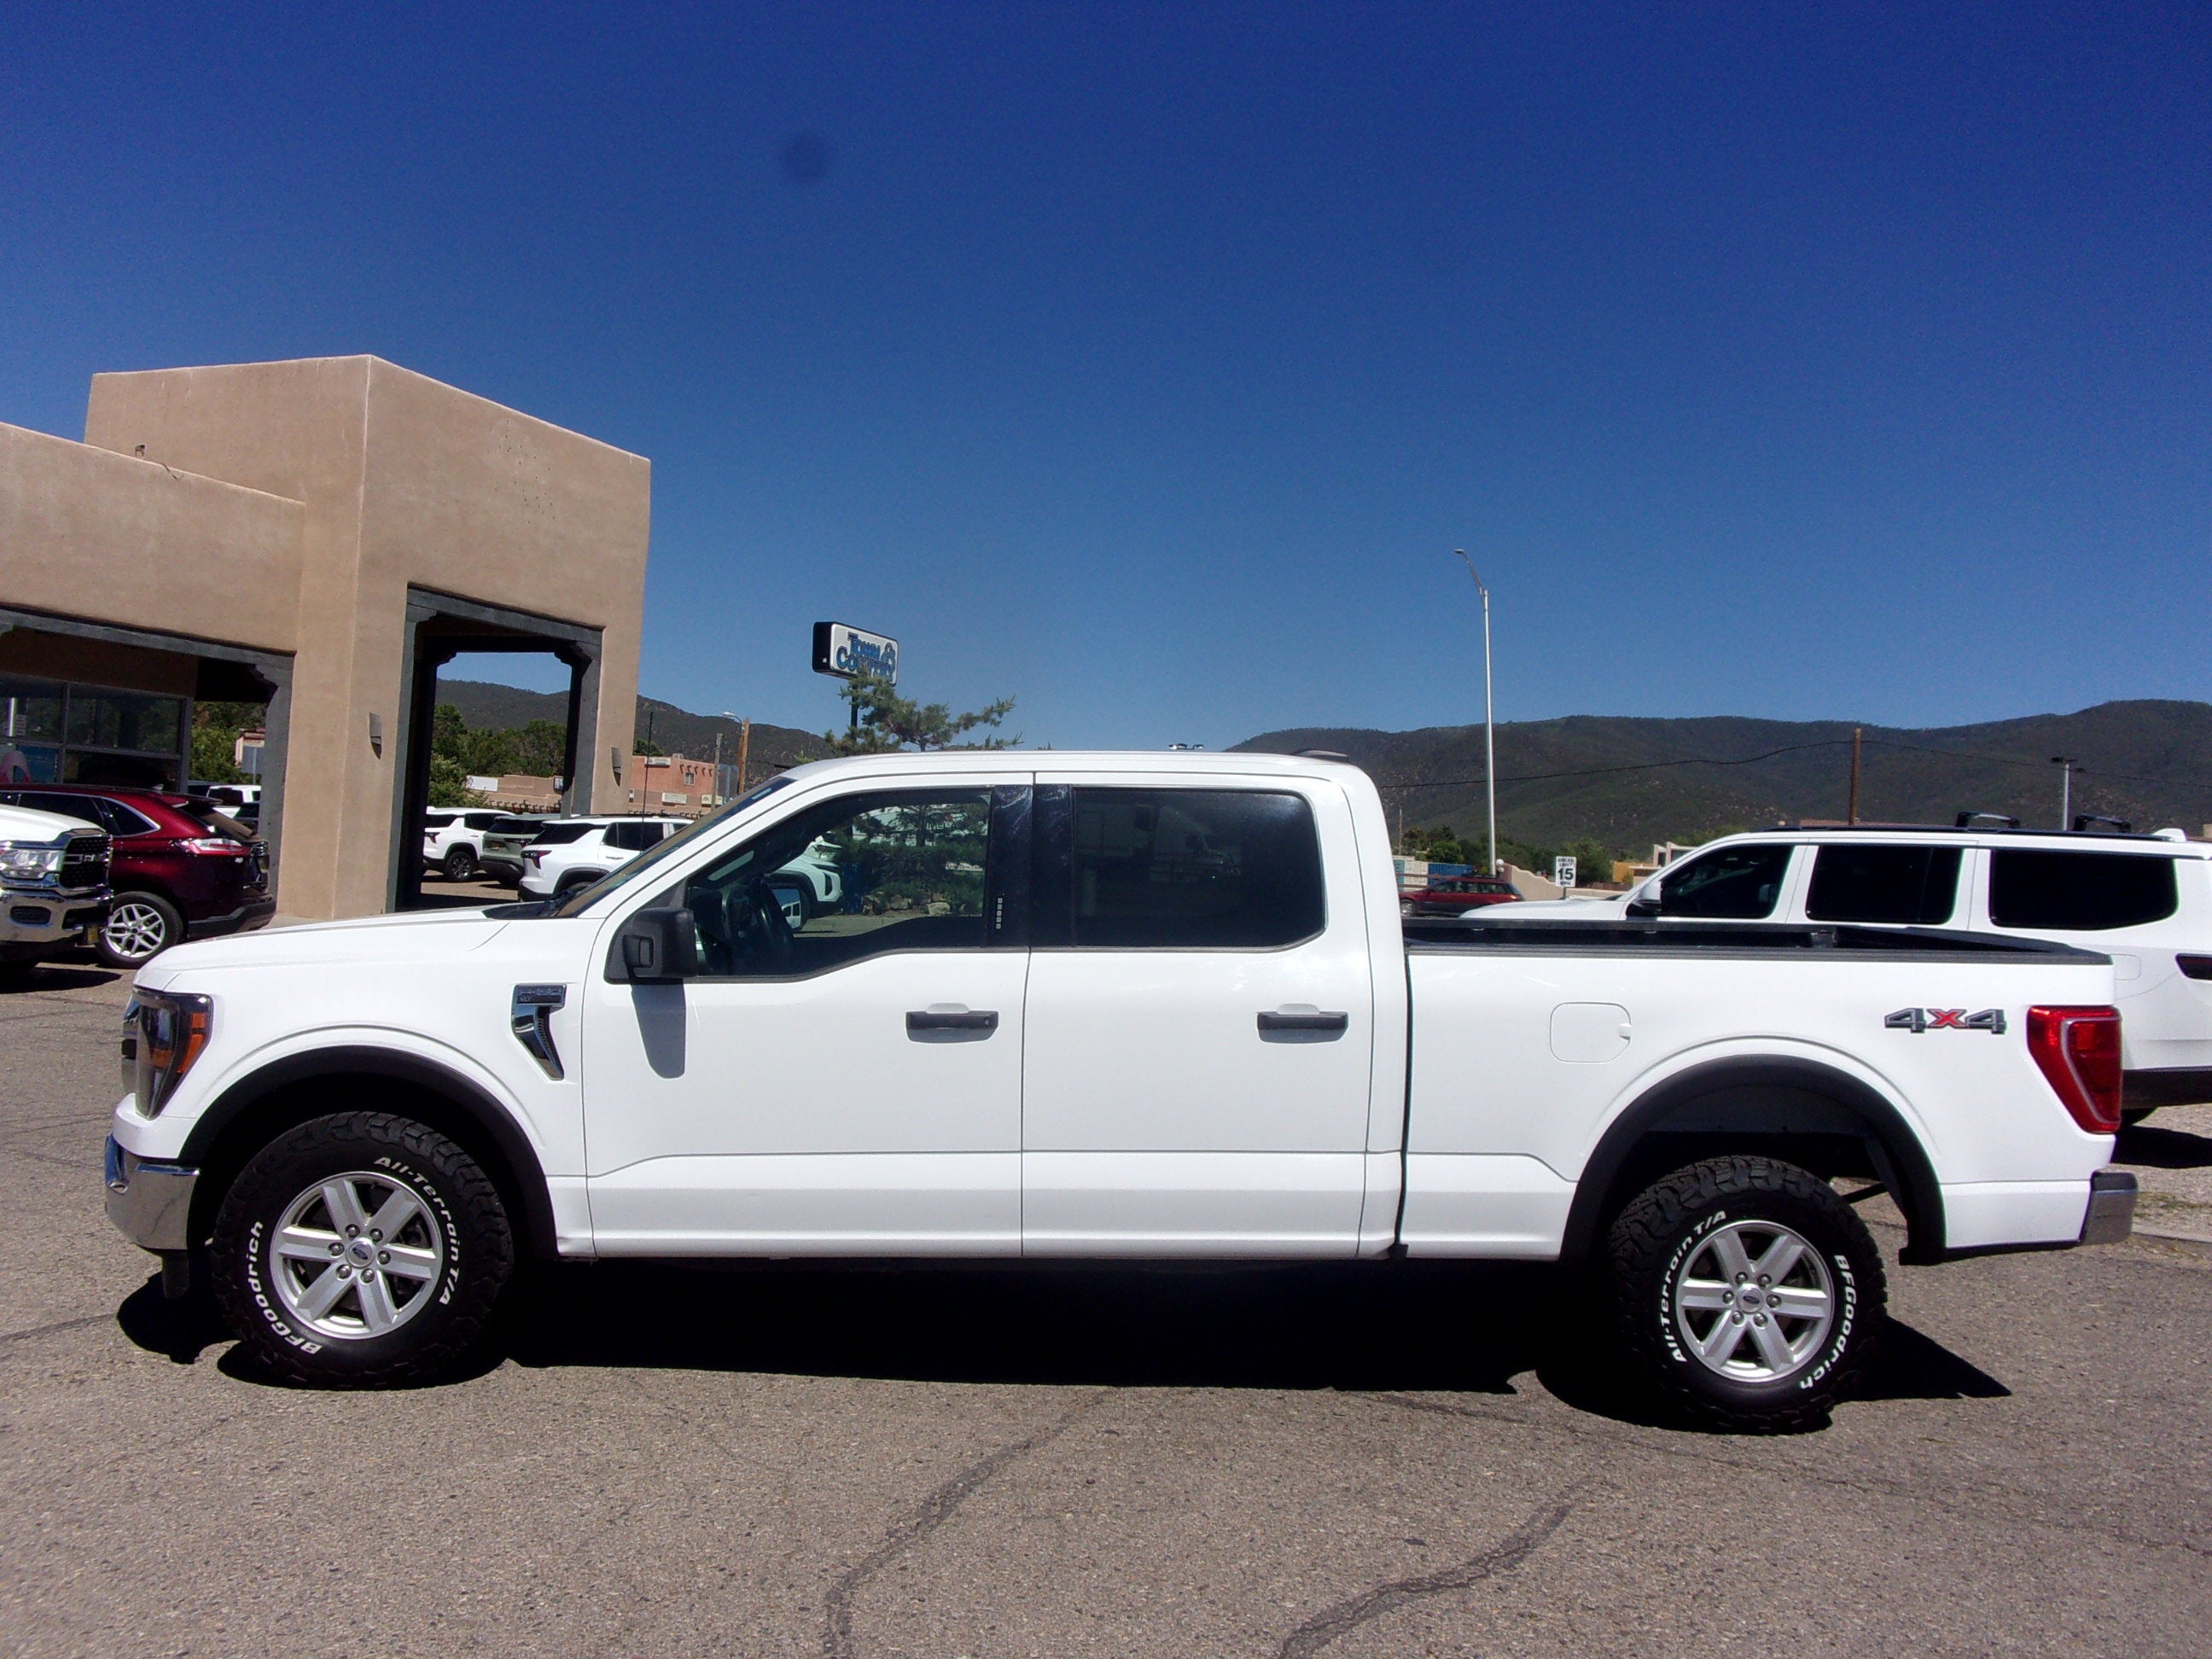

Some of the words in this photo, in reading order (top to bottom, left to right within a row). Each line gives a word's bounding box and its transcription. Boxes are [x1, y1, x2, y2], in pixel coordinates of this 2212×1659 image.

[1557, 868, 1574, 880] 15
[246, 1220, 323, 1354] BFGoodrich
[374, 1156, 460, 1263] All-Terrain
[439, 1268, 459, 1305] T/A
[1659, 1237, 1692, 1363] All-Terrain
[1693, 1210, 1726, 1236] T/A
[1800, 1254, 1856, 1389] BFGoodrich
